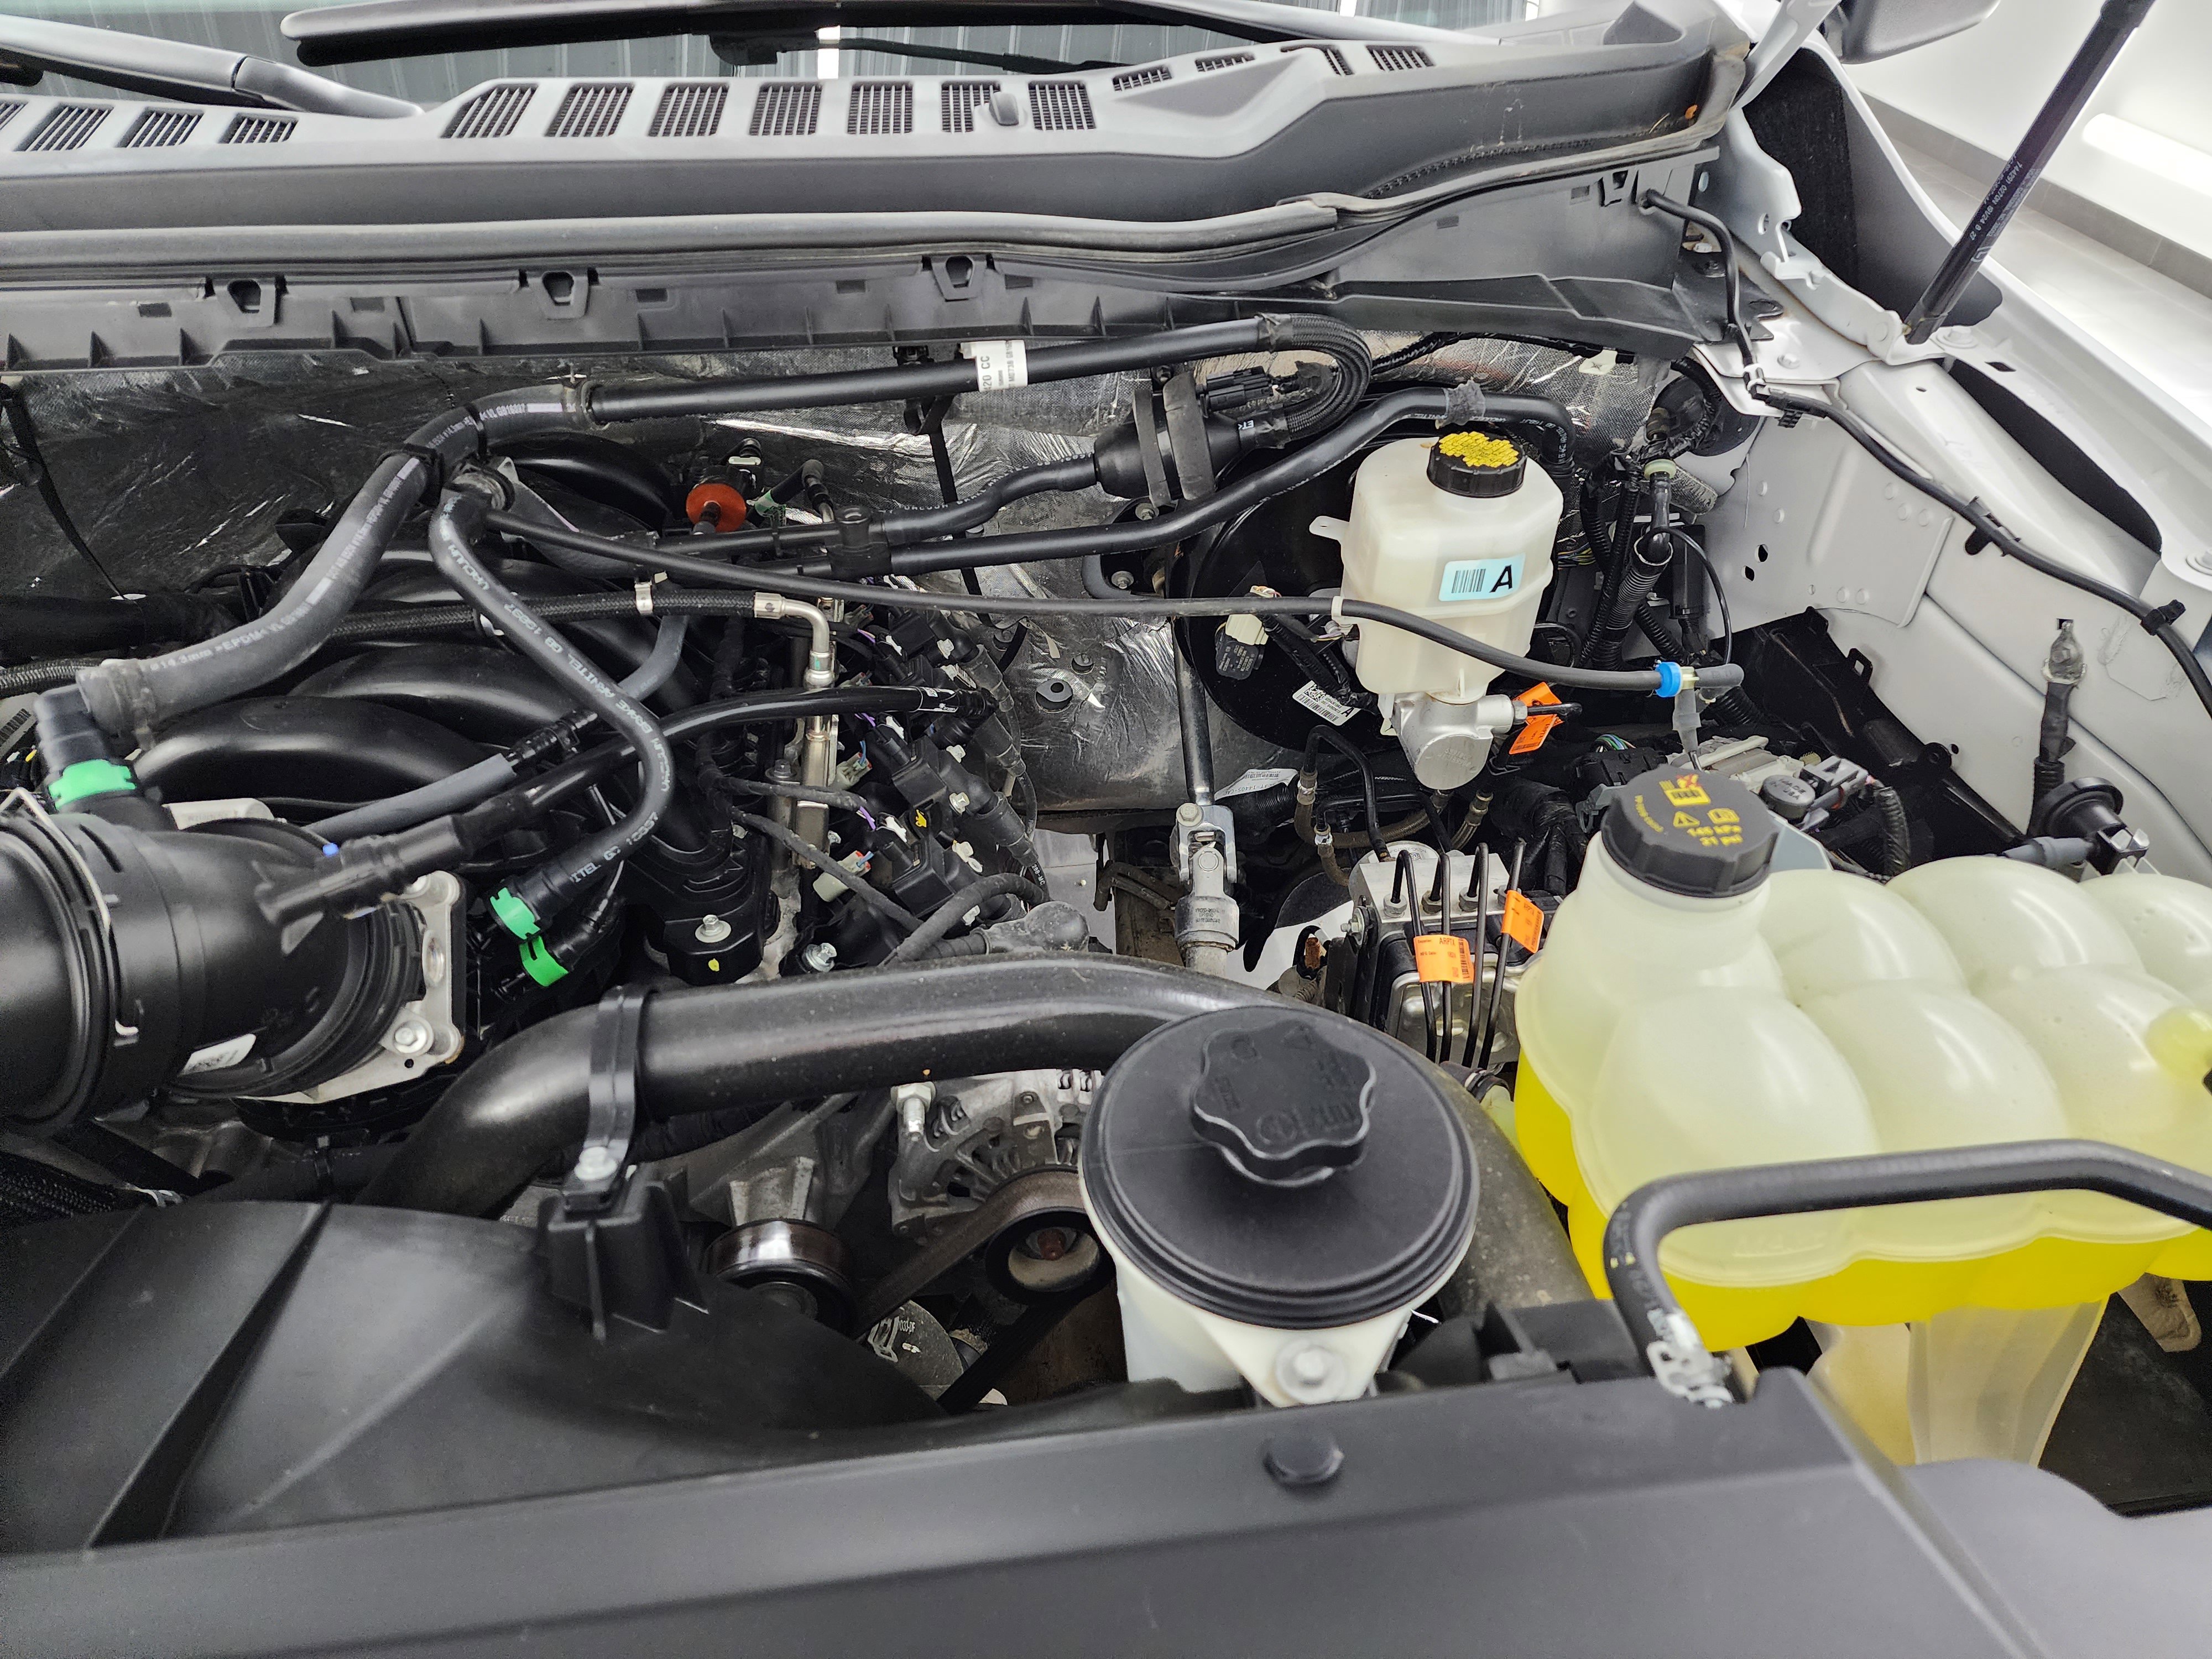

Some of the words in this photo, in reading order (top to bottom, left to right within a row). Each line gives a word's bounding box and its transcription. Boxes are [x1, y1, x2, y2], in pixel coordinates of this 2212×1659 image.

[980, 356, 990, 369] CC
[1490, 565, 1514, 593] A
[545, 636, 564, 654] GB
[567, 653, 615, 698] ARNITEL
[615, 699, 653, 733] BRAKE
[1340, 707, 1354, 718] A
